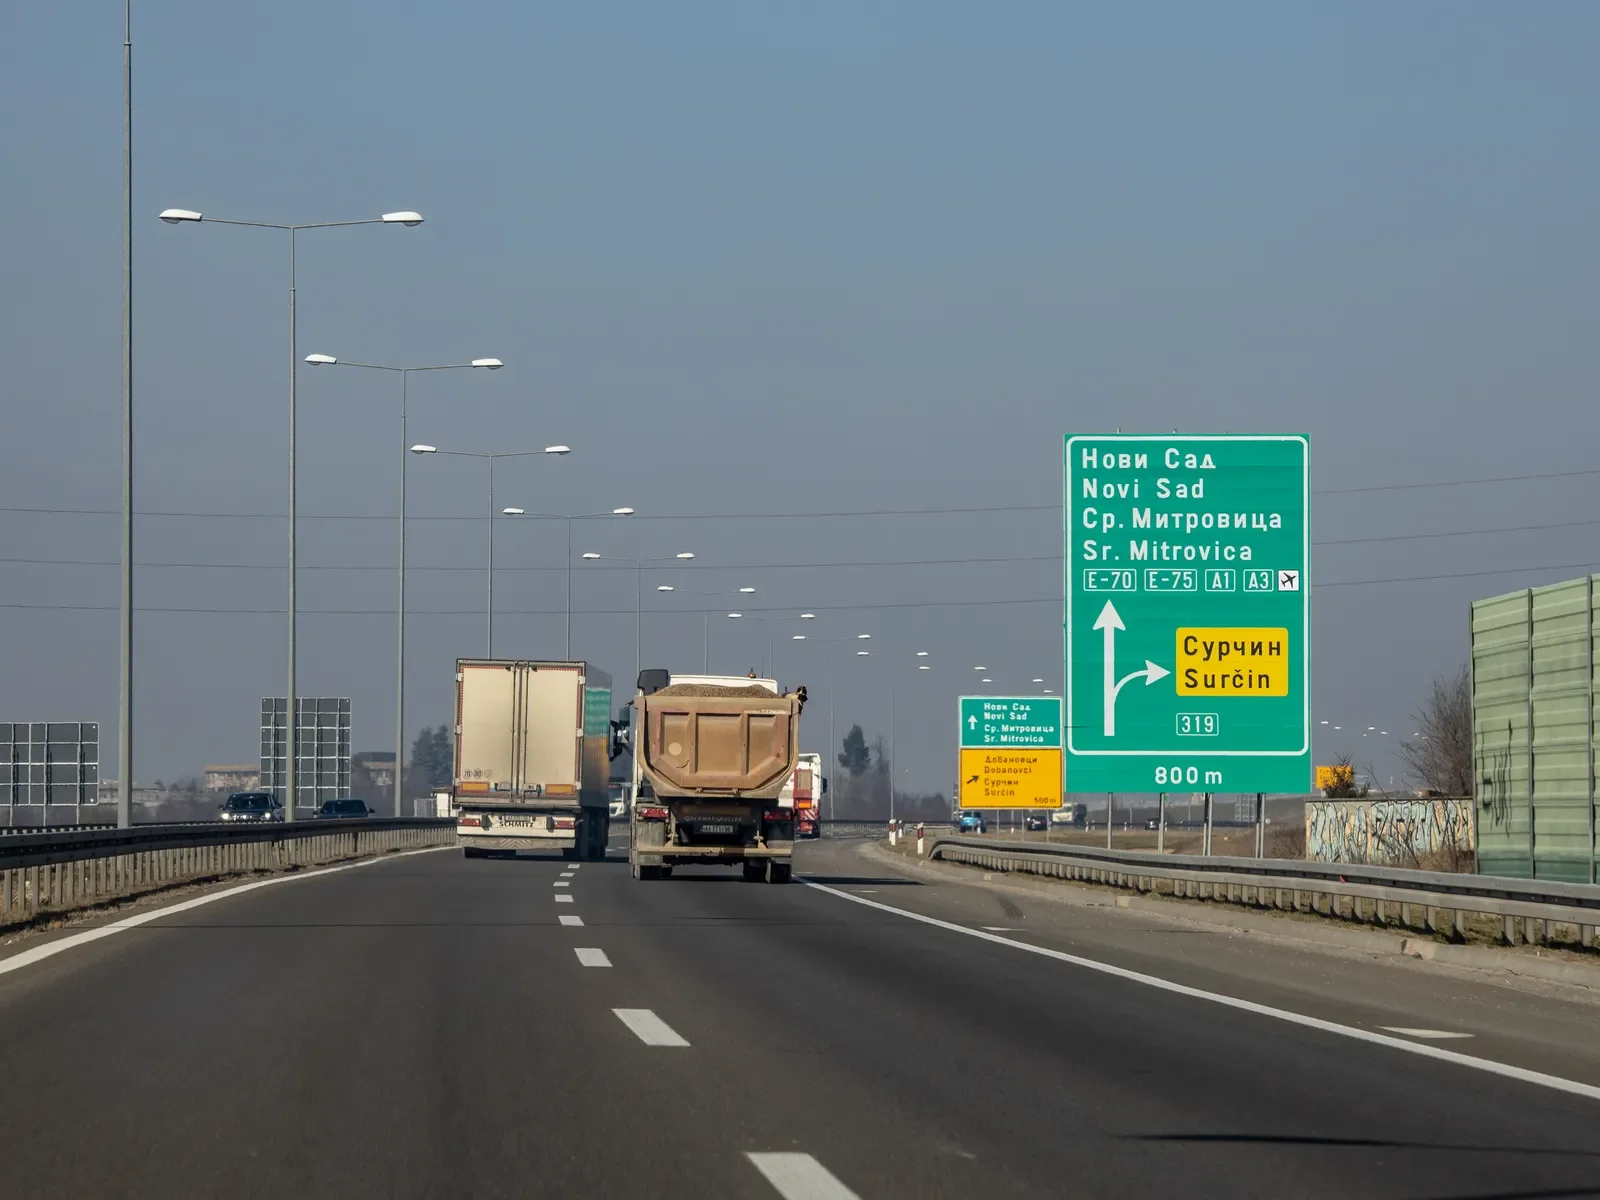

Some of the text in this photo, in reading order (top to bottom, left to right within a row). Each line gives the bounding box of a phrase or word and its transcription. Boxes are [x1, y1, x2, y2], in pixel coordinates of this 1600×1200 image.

[1082, 447, 1216, 469] Нови Сад
[1082, 477, 1204, 499] Novi Sad
[1082, 507, 1282, 533] Ср. Митровица
[1083, 540, 1252, 561] Sr. Mitrovica
[1088, 571, 1269, 589] E-70 E-75 A1 A3
[1183, 635, 1281, 661] Сурчин
[1184, 668, 1270, 689] Surčin
[984, 703, 1031, 711] Нови Сад
[984, 712, 1028, 720] Novi Sad
[1001, 724, 1054, 733] Митровица
[1181, 715, 1214, 733] 319
[984, 735, 1044, 743] Sr. Mitrovica
[984, 766, 1032, 774] Dobanovci
[1154, 766, 1223, 784] 800 m
[984, 778, 1019, 787] Сурчин
[499, 820, 534, 828] SCHMITZ
